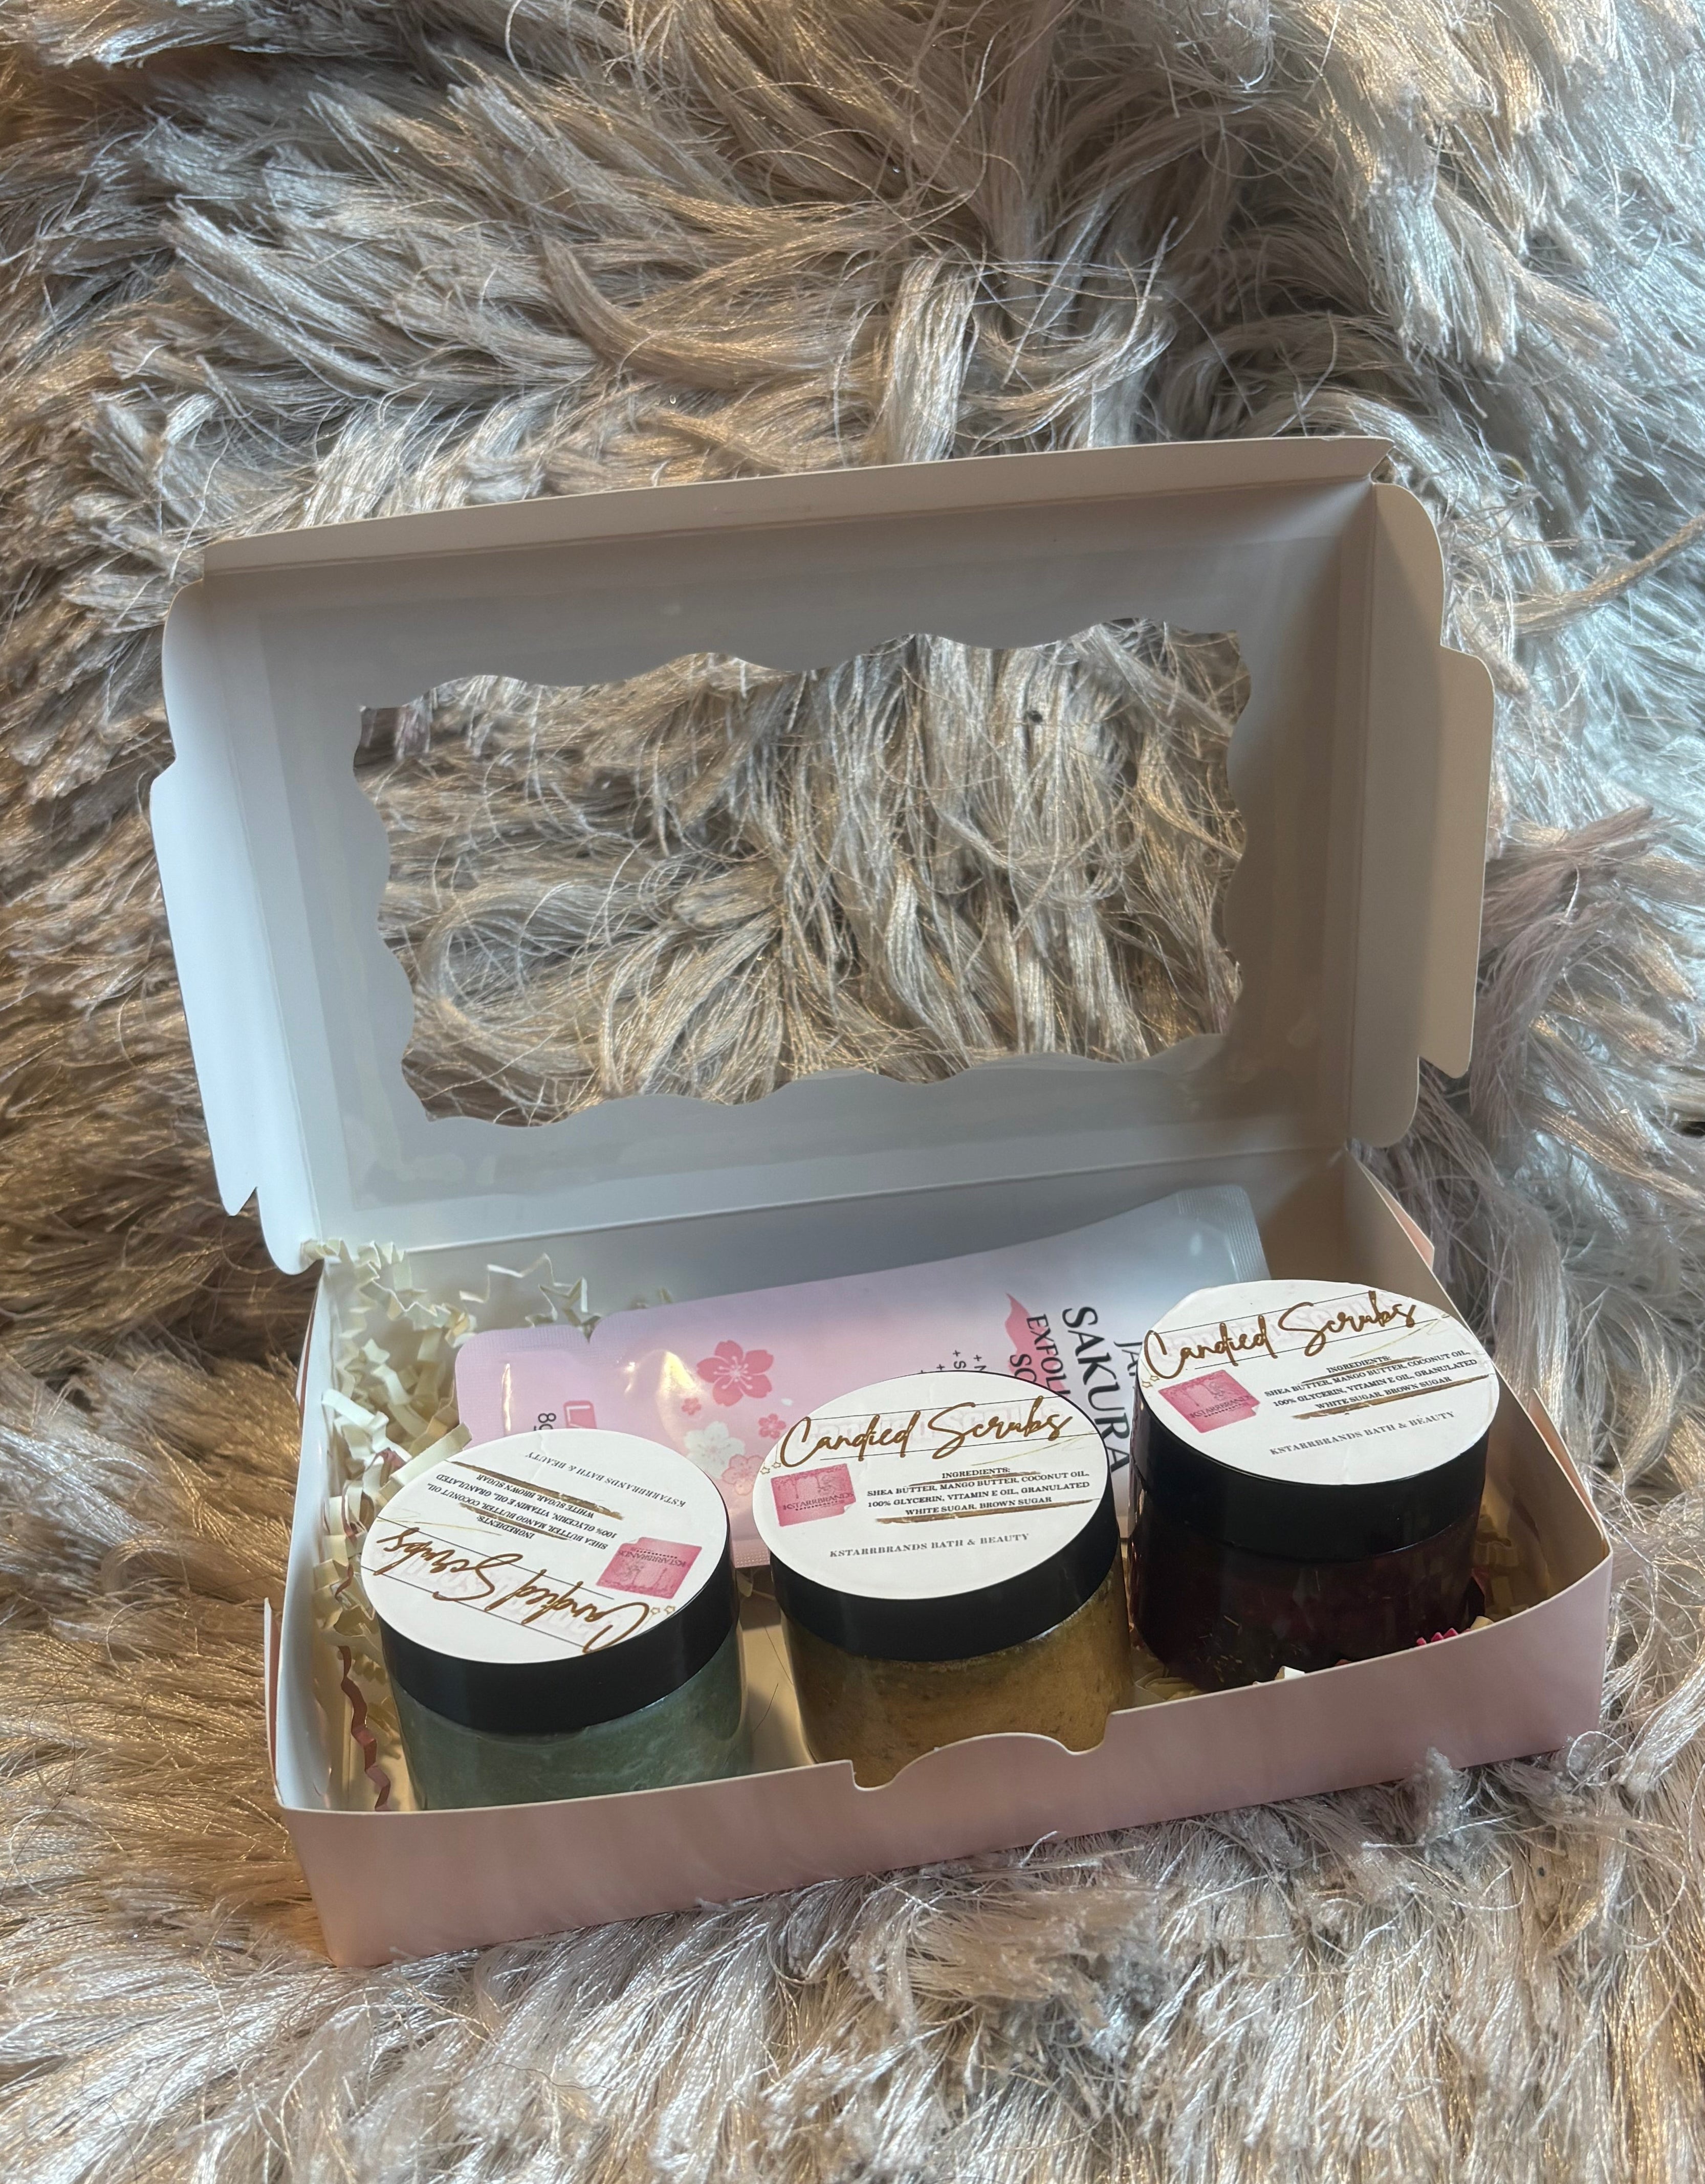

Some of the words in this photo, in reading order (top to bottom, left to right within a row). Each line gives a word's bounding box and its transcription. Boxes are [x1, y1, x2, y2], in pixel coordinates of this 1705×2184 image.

[1144, 1314, 1279, 1380] Candied
[1278, 1290, 1417, 1357] Scrubs
[1326, 1356, 1392, 1373] INGREDIENTS:
[1264, 1388, 1291, 1397] SHEA
[1331, 1372, 1366, 1383] MANGO
[1407, 1354, 1450, 1367] COCONUT
[1273, 1398, 1297, 1406] 100%
[1297, 1388, 1347, 1402] GLYCERIN,
[1346, 1378, 1386, 1391] VITAMIN
[1414, 1359, 1478, 1377] GRANULATED
[1062, 1306, 1130, 1473] SAKURA
[1315, 1398, 1349, 1409] WHITE
[1384, 1383, 1419, 1395] BROWN
[1419, 1376, 1452, 1387] SUGAR
[779, 1410, 922, 1468] Candied
[927, 1395, 1073, 1460] Scrubs
[1269, 1431, 1363, 1455] KSTARRBRANDS
[1365, 1424, 1396, 1436] BATH
[1408, 1411, 1455, 1427] BEAUTY
[526, 1451, 567, 1469] BEAUTY
[476, 1474, 504, 1488] SUGAR
[576, 1468, 605, 1482] BATH
[940, 1482, 975, 1490] MANGO
[1021, 1472, 1069, 1482] COCONUT
[942, 1467, 1010, 1479] INGREDIENTS:
[436, 1474, 492, 1497] GRANULATED
[504, 1484, 535, 1499] BROWN
[947, 1491, 989, 1500] VITAMIN
[1021, 1482, 1090, 1493] GRANULATED
[440, 1489, 480, 1507] COCONUT
[905, 1507, 939, 1515] WHITE
[979, 1499, 1015, 1509] BROWN
[1018, 1496, 1052, 1505] SUGAR
[514, 1500, 550, 1517] VITAMIN
[565, 1505, 595, 1519] WHITE
[476, 1515, 535, 1539] INGREDIENTS:
[516, 1515, 549, 1530] MANGO
[597, 1528, 618, 1539] 100%
[584, 1537, 608, 1550] SHEA
[829, 1542, 927, 1557] KSTARRBRANDS
[931, 1539, 964, 1549] BATH
[979, 1533, 1029, 1544] BEAUTY
[373, 1527, 523, 1601] Scrubs
[484, 1569, 650, 1654] Candied
